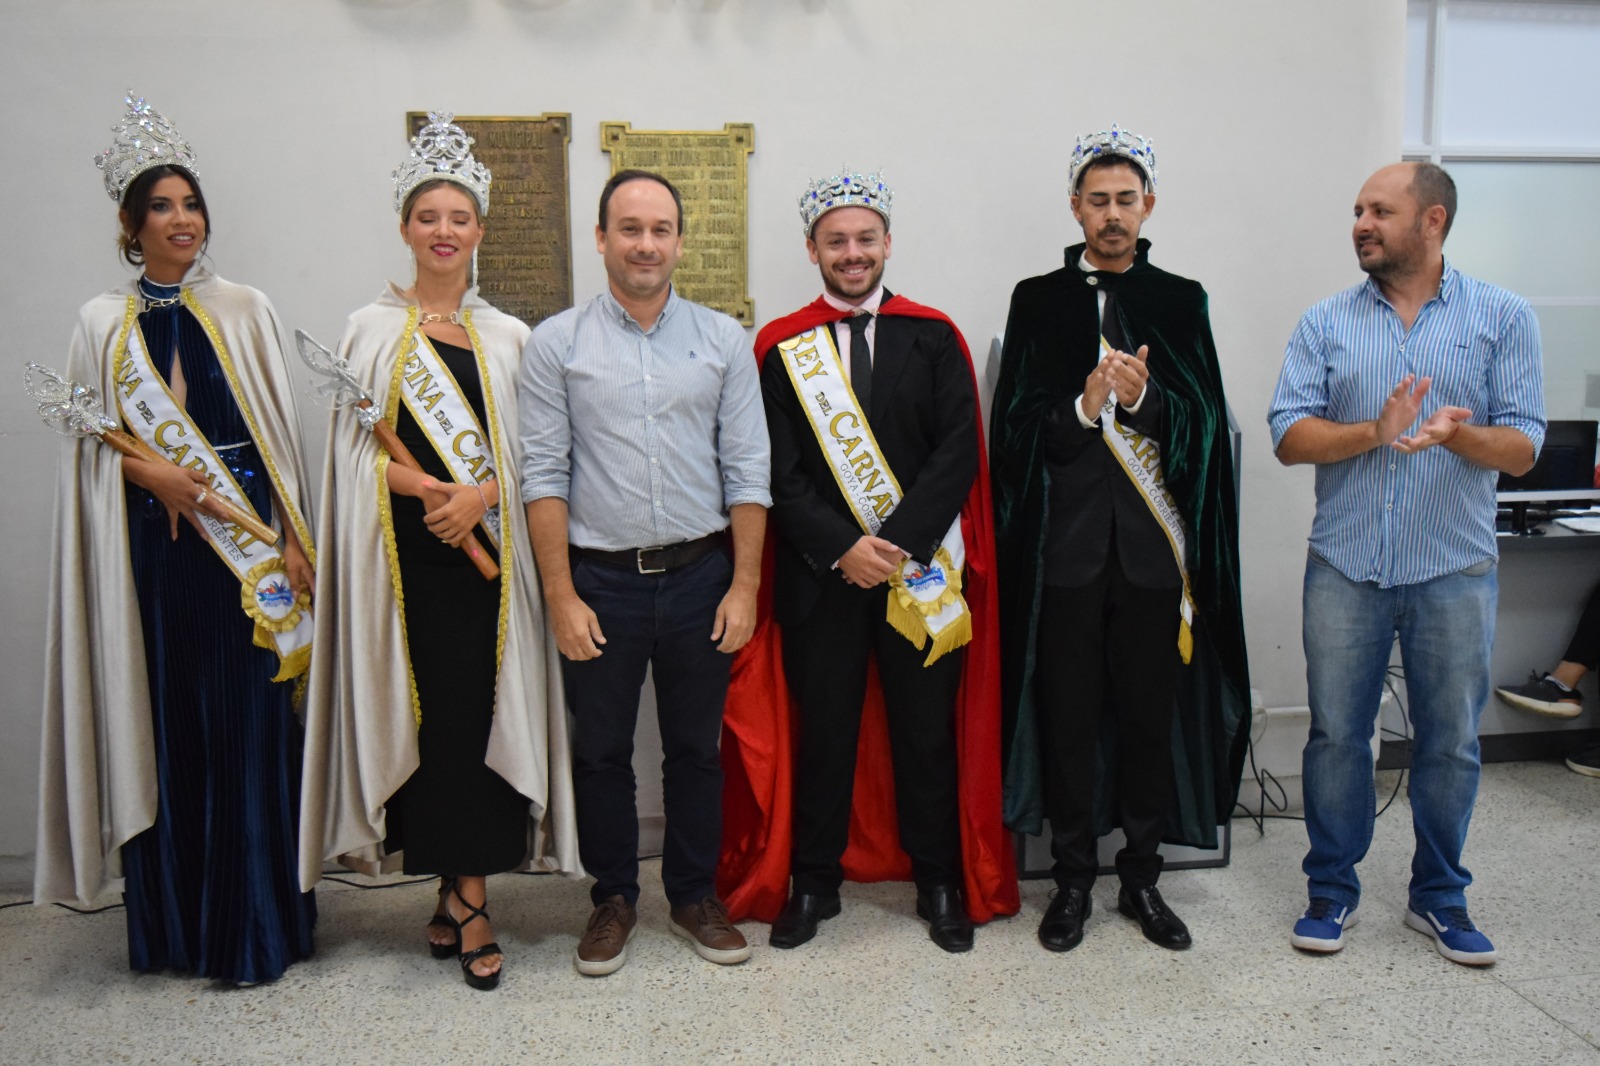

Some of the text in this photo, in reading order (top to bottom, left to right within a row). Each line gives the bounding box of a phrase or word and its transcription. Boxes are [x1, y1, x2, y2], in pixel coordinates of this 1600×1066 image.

[135, 400, 155, 425] DEL
[815, 391, 832, 417] DEL
[433, 409, 454, 435] DEL
[840, 463, 858, 492] GOYA
[1127, 457, 1147, 485] GOYA
[1149, 488, 1184, 546] CORRIENTES
[204, 514, 243, 562] RRIENTES
